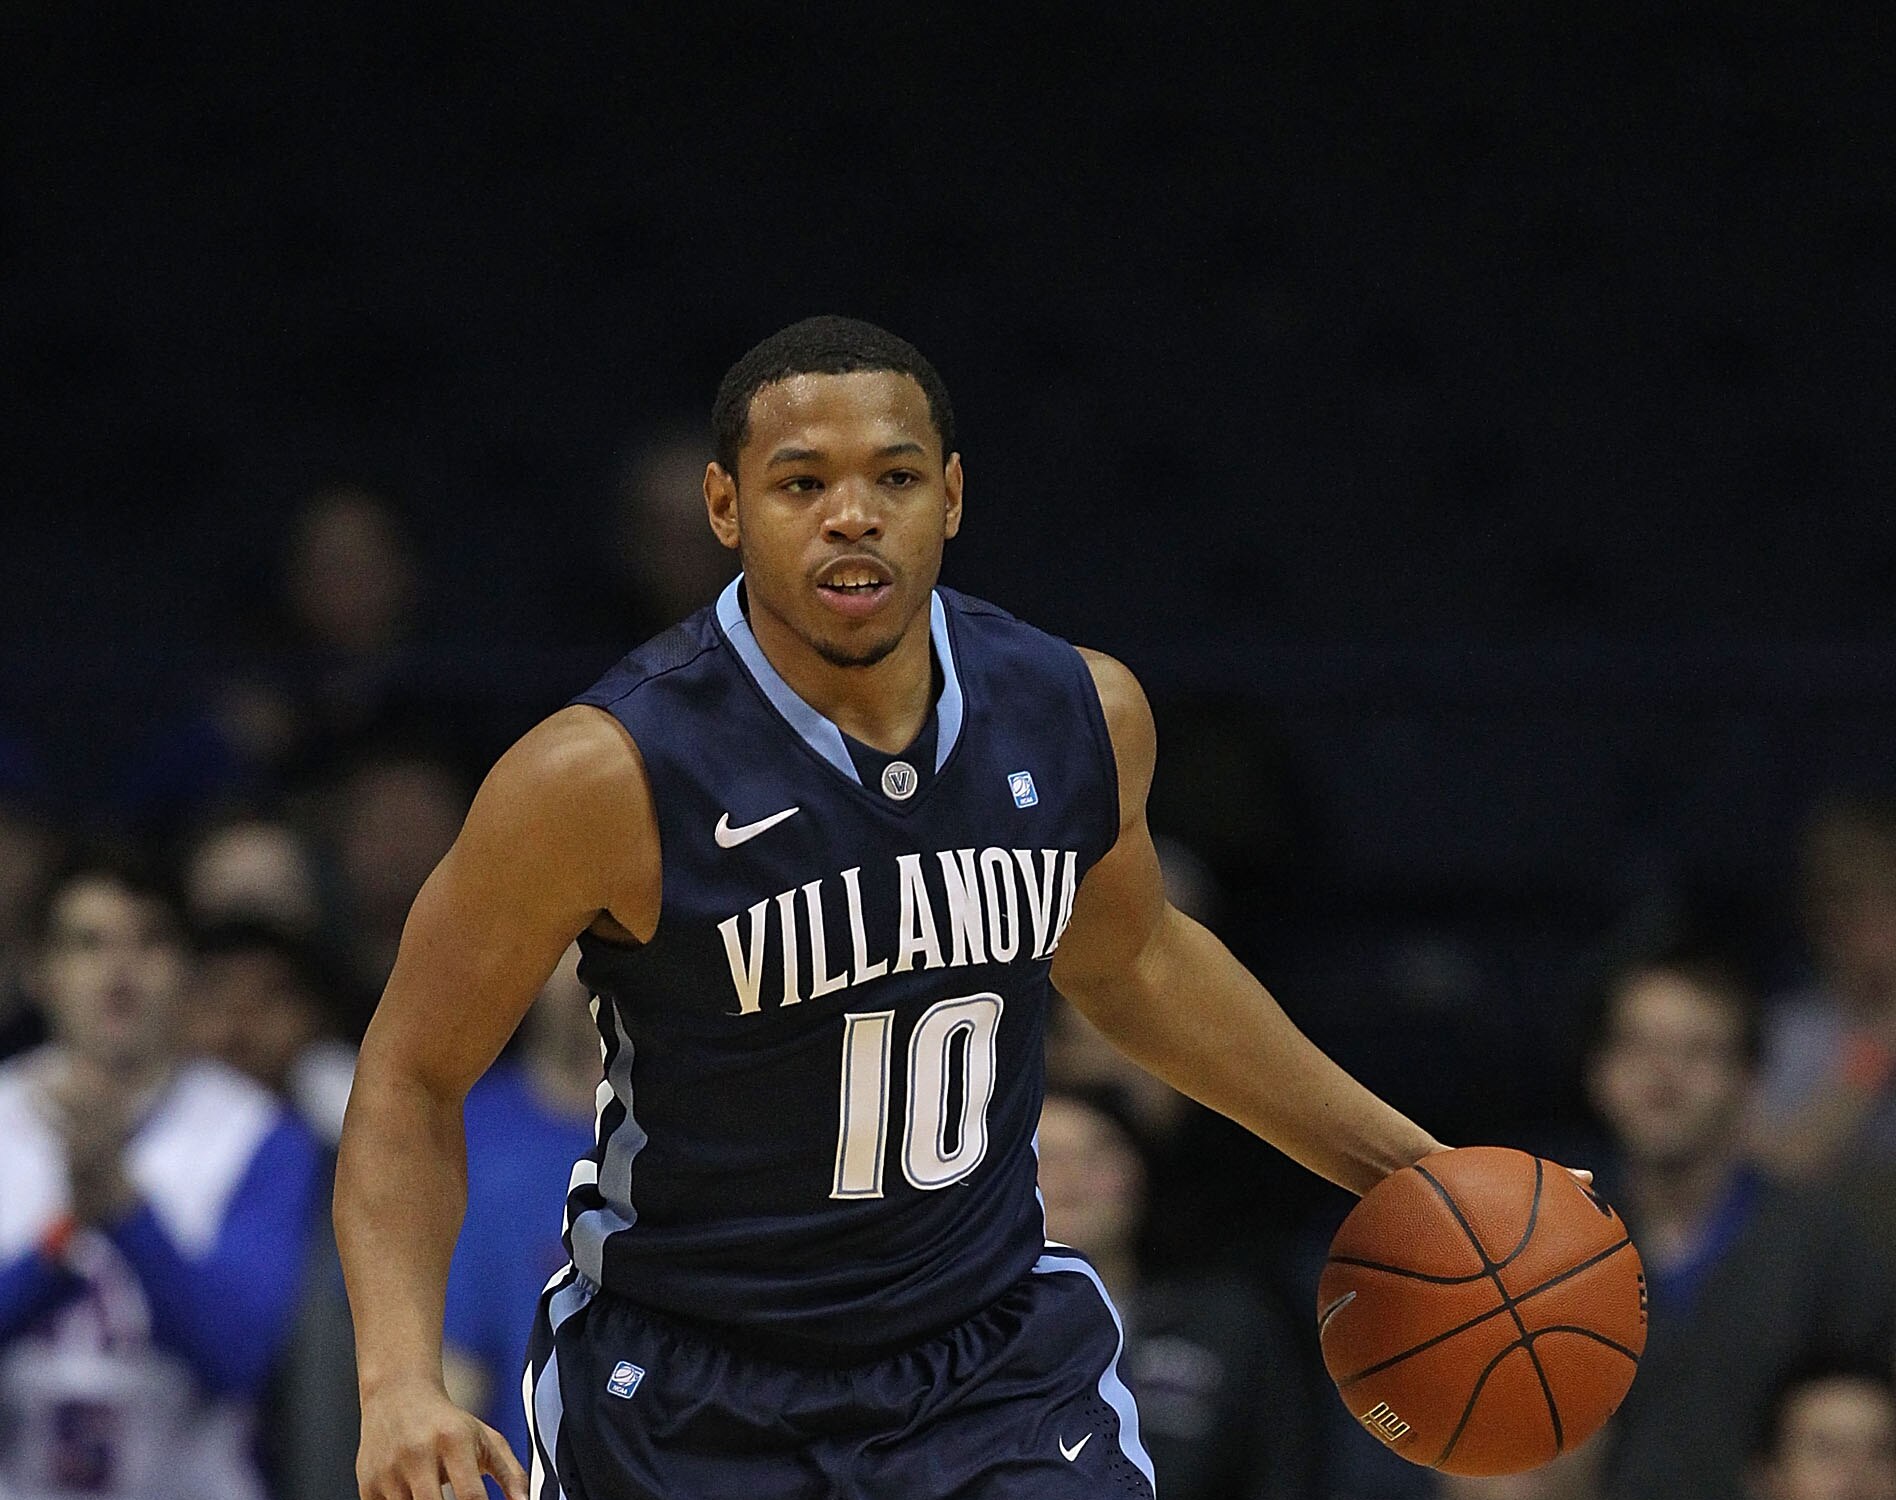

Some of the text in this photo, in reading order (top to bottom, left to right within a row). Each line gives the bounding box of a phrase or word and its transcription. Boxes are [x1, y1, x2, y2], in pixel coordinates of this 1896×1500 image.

[889, 770, 911, 794] V
[717, 846, 1078, 1014] VILLANOVA
[828, 992, 1005, 1199] 10
